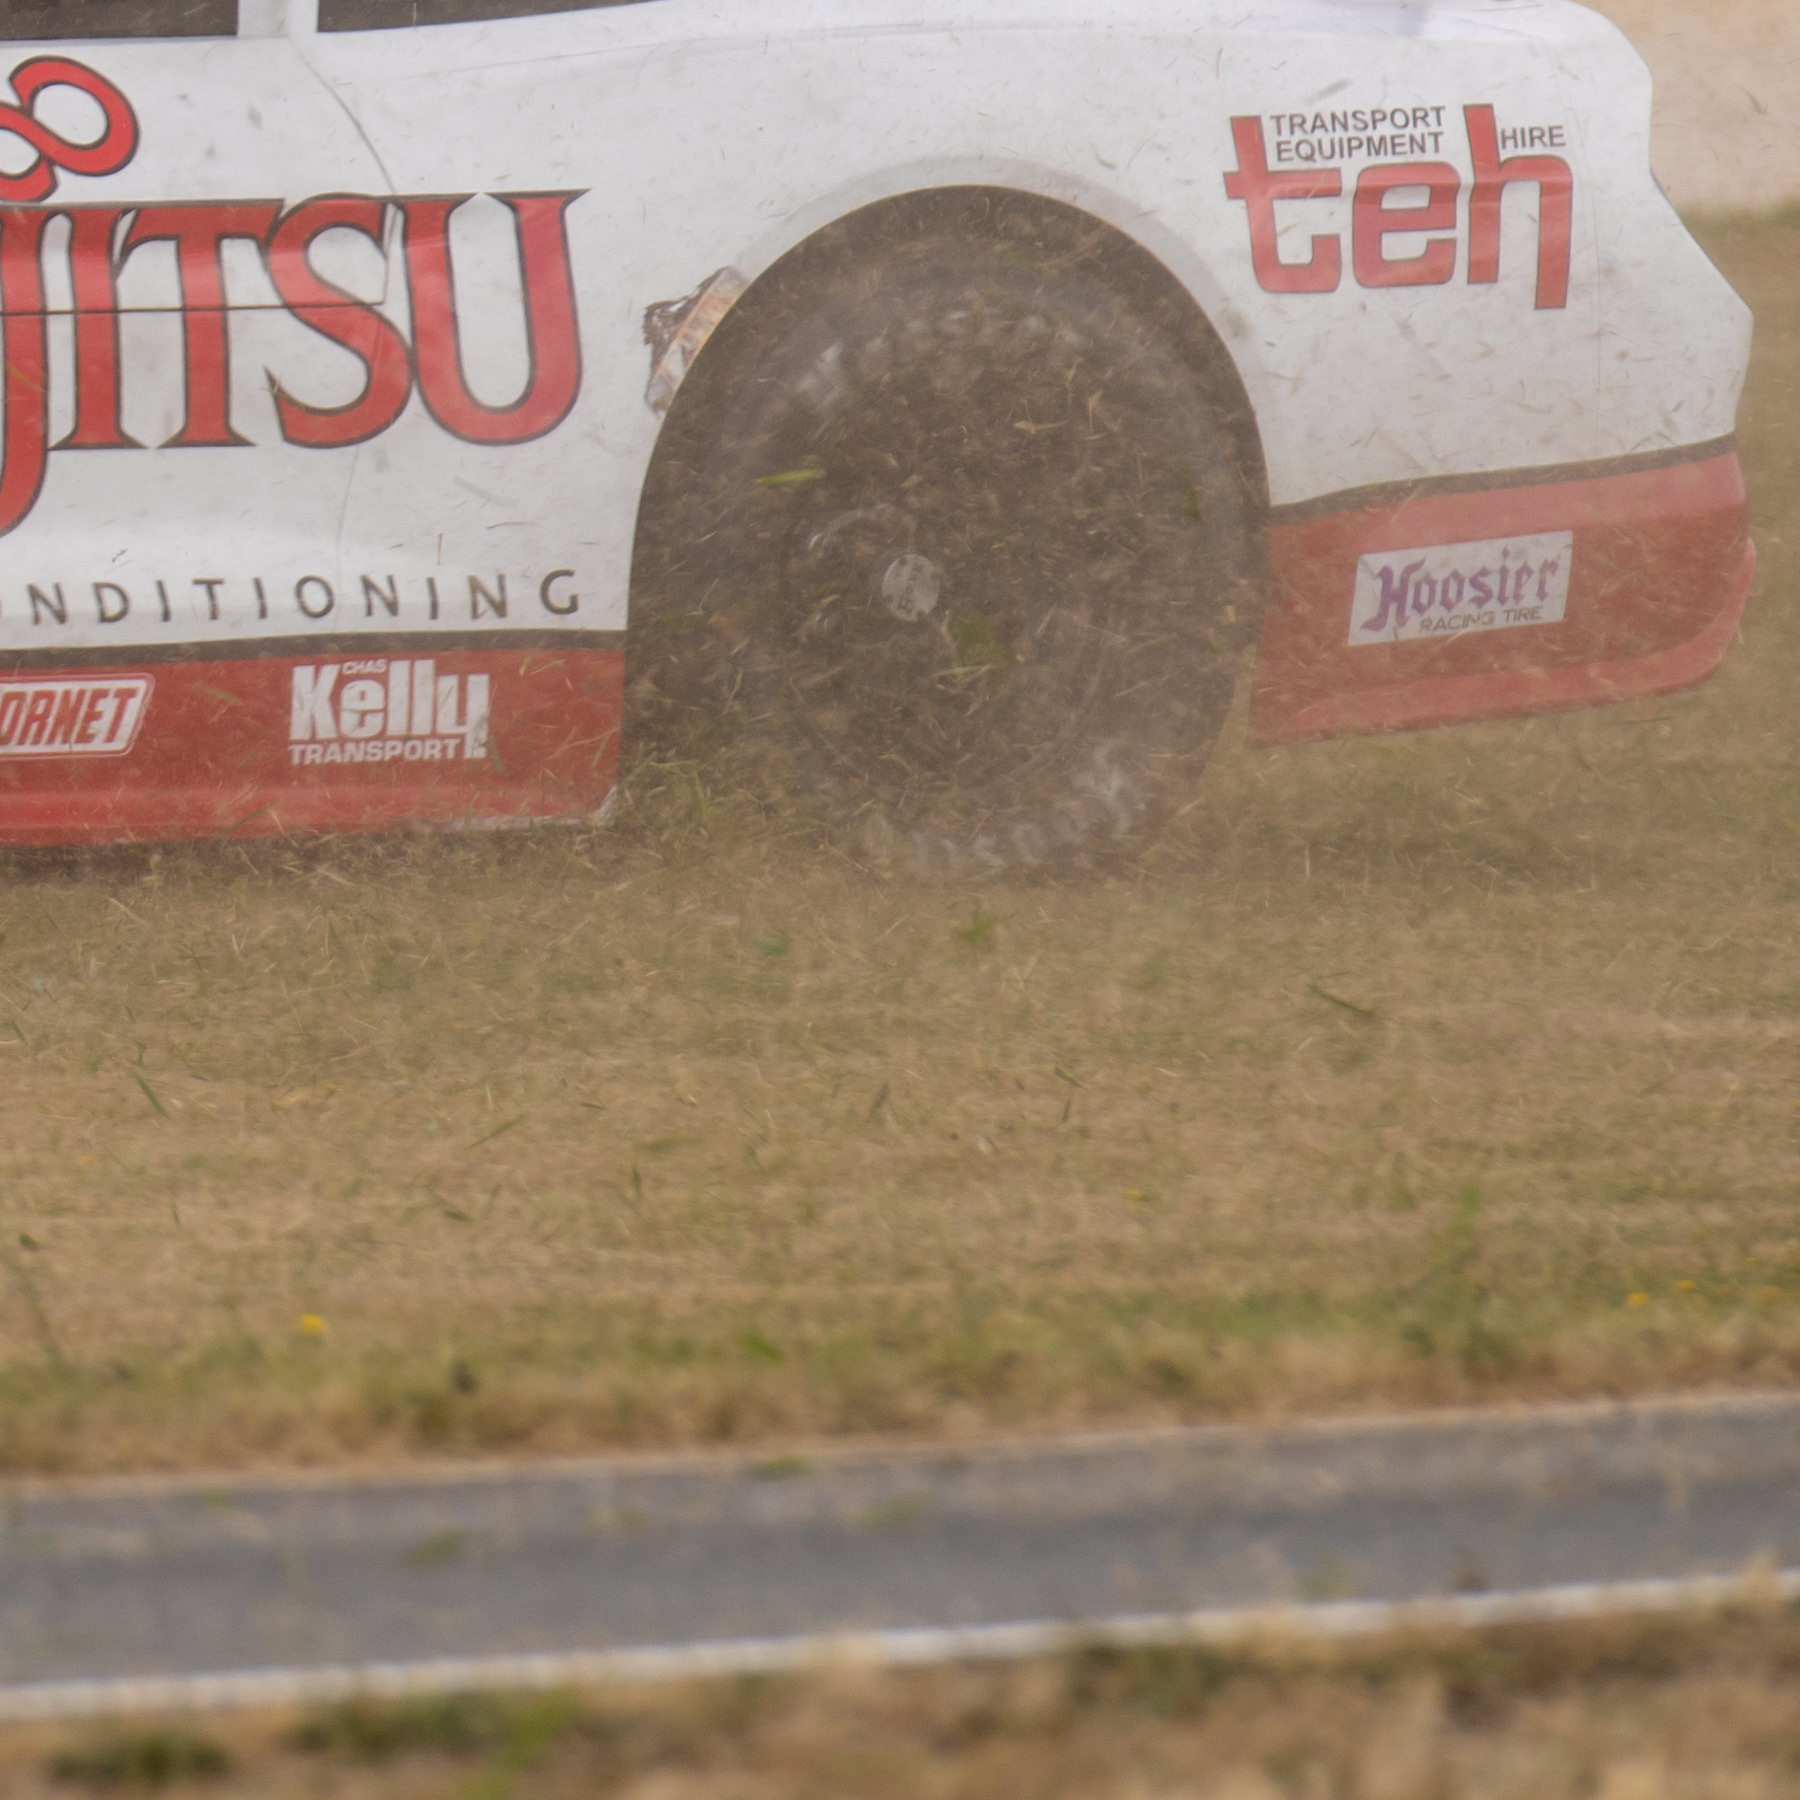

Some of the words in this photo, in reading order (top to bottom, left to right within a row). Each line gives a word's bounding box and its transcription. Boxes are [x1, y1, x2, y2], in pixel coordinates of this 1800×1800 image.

[1269, 105, 1447, 137] TRANSPORT
[1276, 131, 1444, 163] EQUIPMENT
[1500, 124, 1567, 150] HIRE
[1359, 545, 1564, 633] Hoosier
[1418, 610, 1496, 634] RACING
[1503, 604, 1543, 622] TIRE
[341, 658, 388, 676] CHAS
[289, 658, 491, 760] Kelly
[289, 738, 460, 767] TRANSPORT
